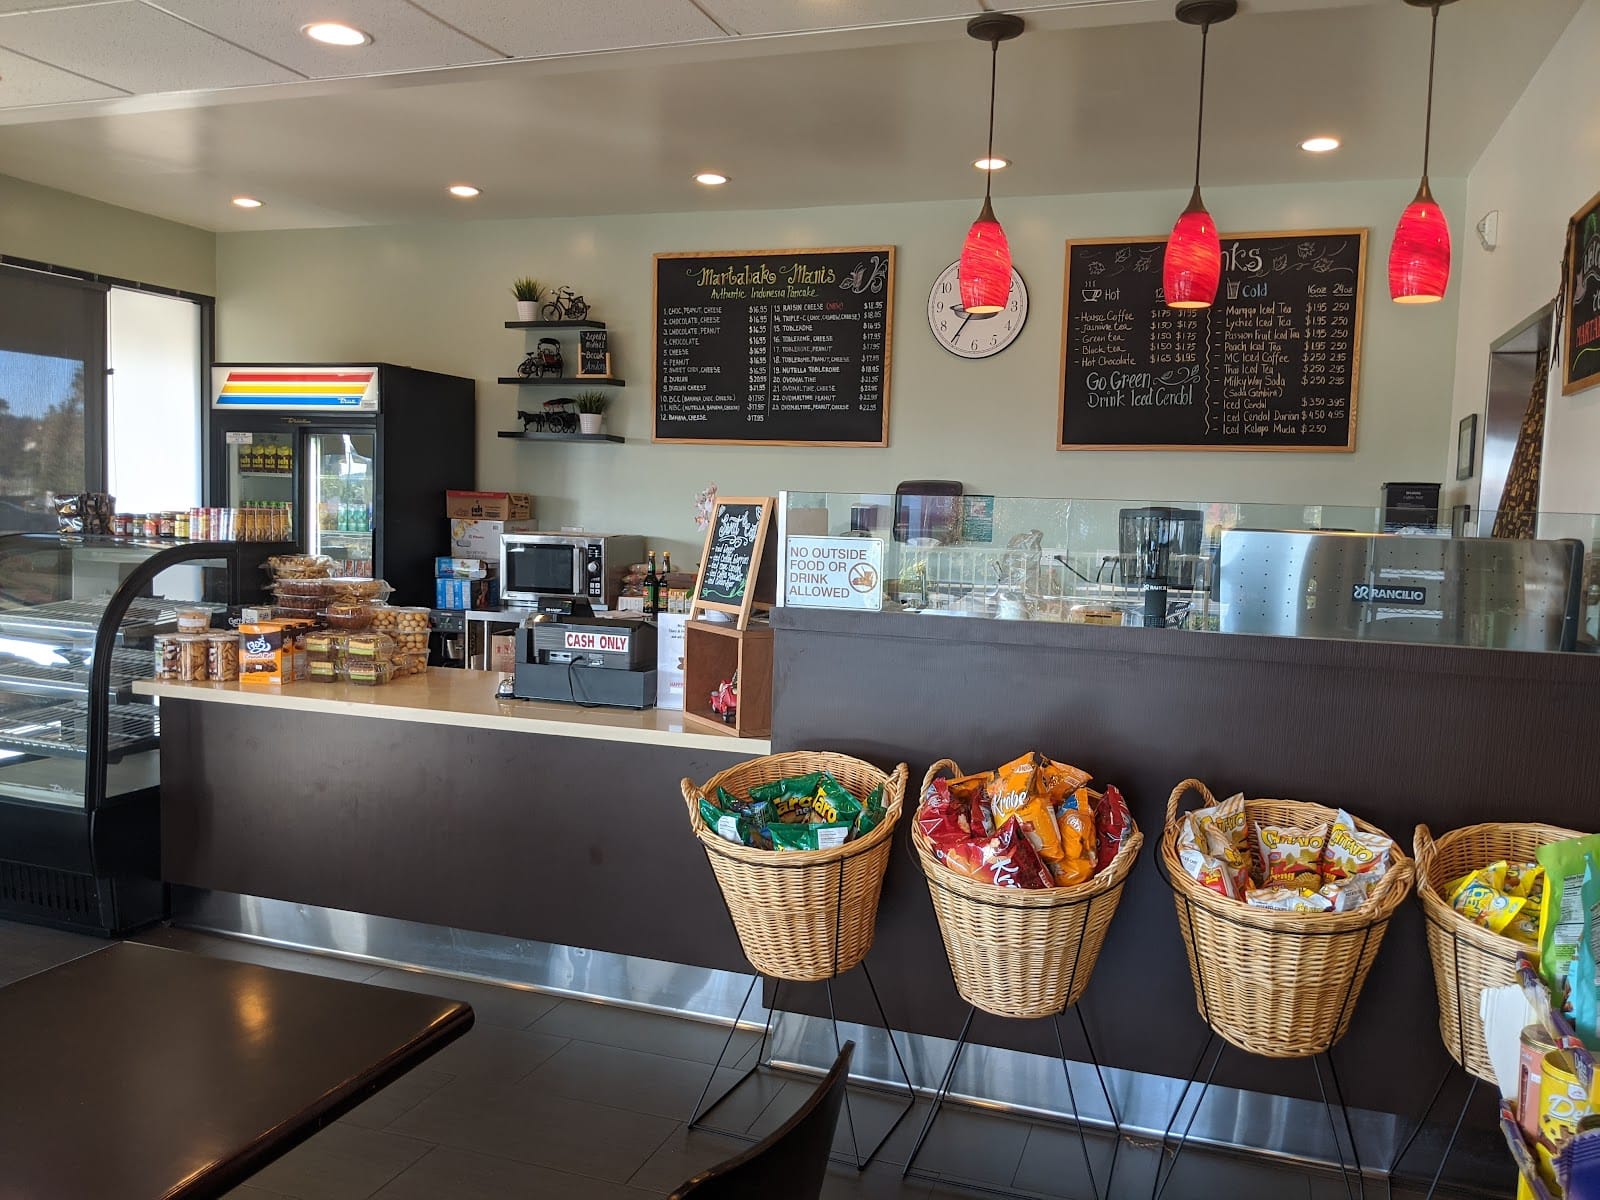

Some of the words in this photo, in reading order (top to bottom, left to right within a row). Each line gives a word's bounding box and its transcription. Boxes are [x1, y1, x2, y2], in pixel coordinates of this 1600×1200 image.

[780, 263, 836, 284] Manis
[710, 288, 747, 299] Authentic
[751, 287, 786, 298] Indonesia
[788, 286, 819, 298] Pancake
[942, 282, 952, 294] 10
[1105, 288, 1120, 300] Hot
[1242, 282, 1268, 298] Cold
[1308, 284, 1327, 294] 16oz
[1332, 284, 1352, 293] 24oz
[936, 302, 944, 312] 9
[1010, 301, 1018, 312] 3
[1226, 306, 1256, 319] Mango
[1260, 301, 1275, 314] Iced
[1278, 302, 1292, 314] Tea
[1081, 312, 1106, 321] House
[1107, 309, 1134, 322] Coffee
[940, 321, 948, 332] 8
[1004, 320, 1011, 331] 4
[1081, 323, 1111, 334] Jasmine
[1226, 318, 1253, 331] Lychee
[1256, 315, 1273, 327] Iced
[1277, 316, 1291, 327] Tea
[990, 334, 998, 346] 5
[1082, 334, 1106, 344] Green
[1225, 330, 1253, 340] Passion
[1255, 329, 1270, 340] Fruit
[1274, 328, 1287, 340] Iced
[1289, 328, 1300, 339] Tea
[970, 340, 978, 351] 6
[1082, 345, 1105, 355] Black
[1224, 341, 1246, 352] Peach
[1250, 342, 1264, 351] Iced
[1269, 342, 1281, 351] Tea
[1082, 356, 1096, 367] Hot
[1098, 354, 1136, 366] Chocolate
[1224, 353, 1239, 363] MC
[1242, 353, 1260, 363] Iced
[1262, 352, 1290, 365] Coffee
[1224, 364, 1239, 374] Thai
[1242, 363, 1258, 374] Iced
[1261, 364, 1274, 374] Tea
[1086, 371, 1107, 390] Go
[1110, 370, 1151, 390] Green
[1224, 376, 1247, 390] Milky
[1265, 373, 1285, 386] Soda
[1087, 389, 1126, 408] Drink
[1131, 387, 1153, 407] Iced
[1156, 384, 1193, 406] Cendol
[1223, 399, 1240, 409] Iced
[1244, 399, 1267, 409] Cendol
[1223, 411, 1240, 422] Iced
[1244, 410, 1270, 422] Cendol
[1274, 410, 1299, 421] Durian
[1223, 424, 1239, 434] Iced
[1273, 424, 1296, 434] Muda
[790, 547, 808, 557] NO
[812, 548, 867, 560] OUTSIDE
[790, 560, 824, 571] FOOD
[828, 562, 847, 572] OR
[790, 573, 828, 584] DRINK
[789, 586, 850, 598] ALLOWED
[1371, 589, 1423, 600] RANCILIO
[567, 634, 594, 648] CASH
[600, 636, 626, 650] ONLY
